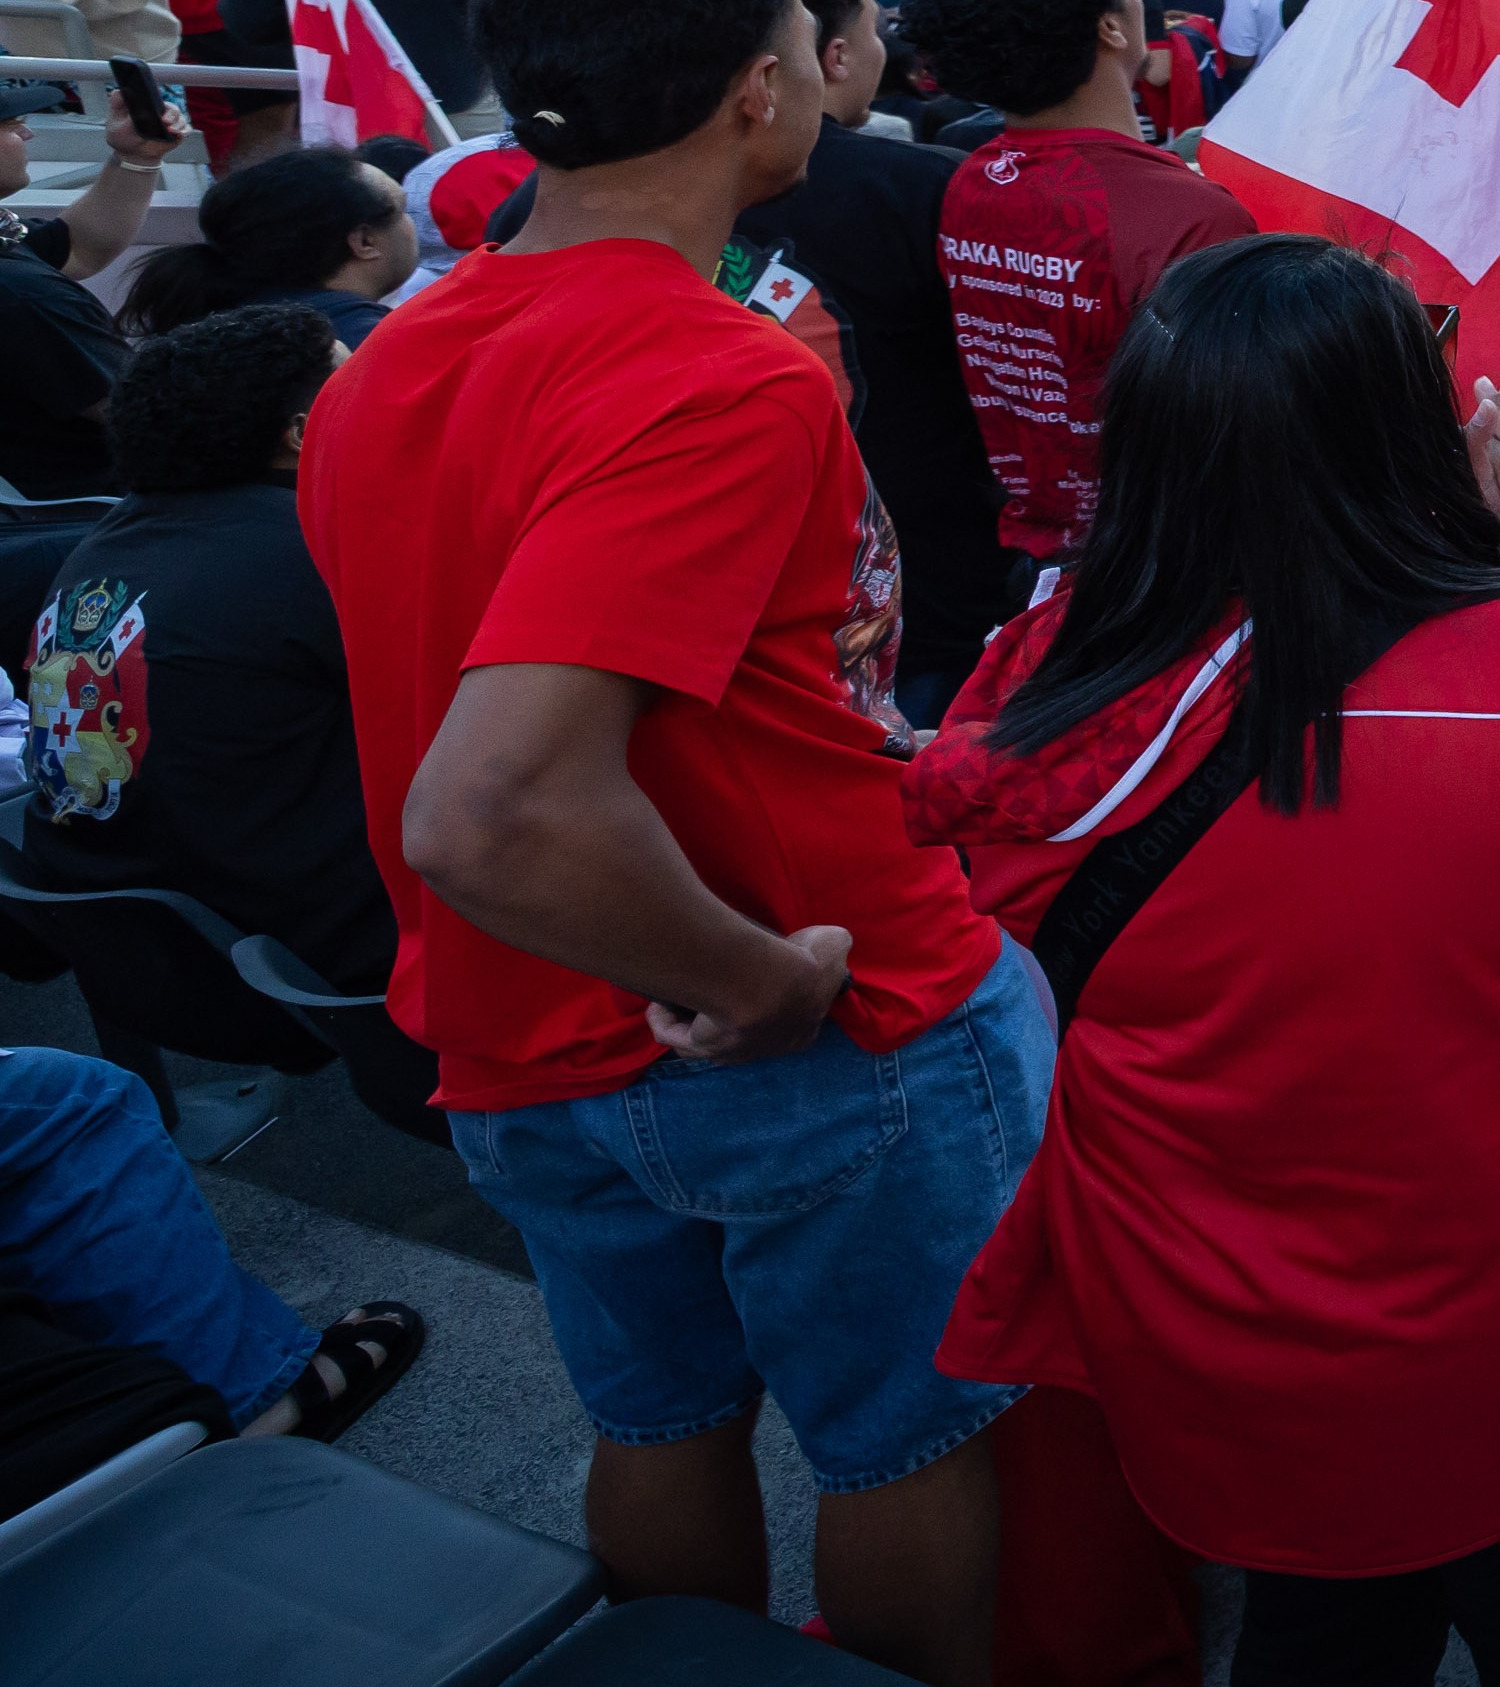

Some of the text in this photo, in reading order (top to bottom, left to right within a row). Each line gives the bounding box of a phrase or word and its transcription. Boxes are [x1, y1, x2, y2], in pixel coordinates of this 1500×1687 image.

[1004, 248, 1083, 283] RUGBY
[961, 273, 1022, 298] sponsored
[1036, 288, 1064, 308] 2023
